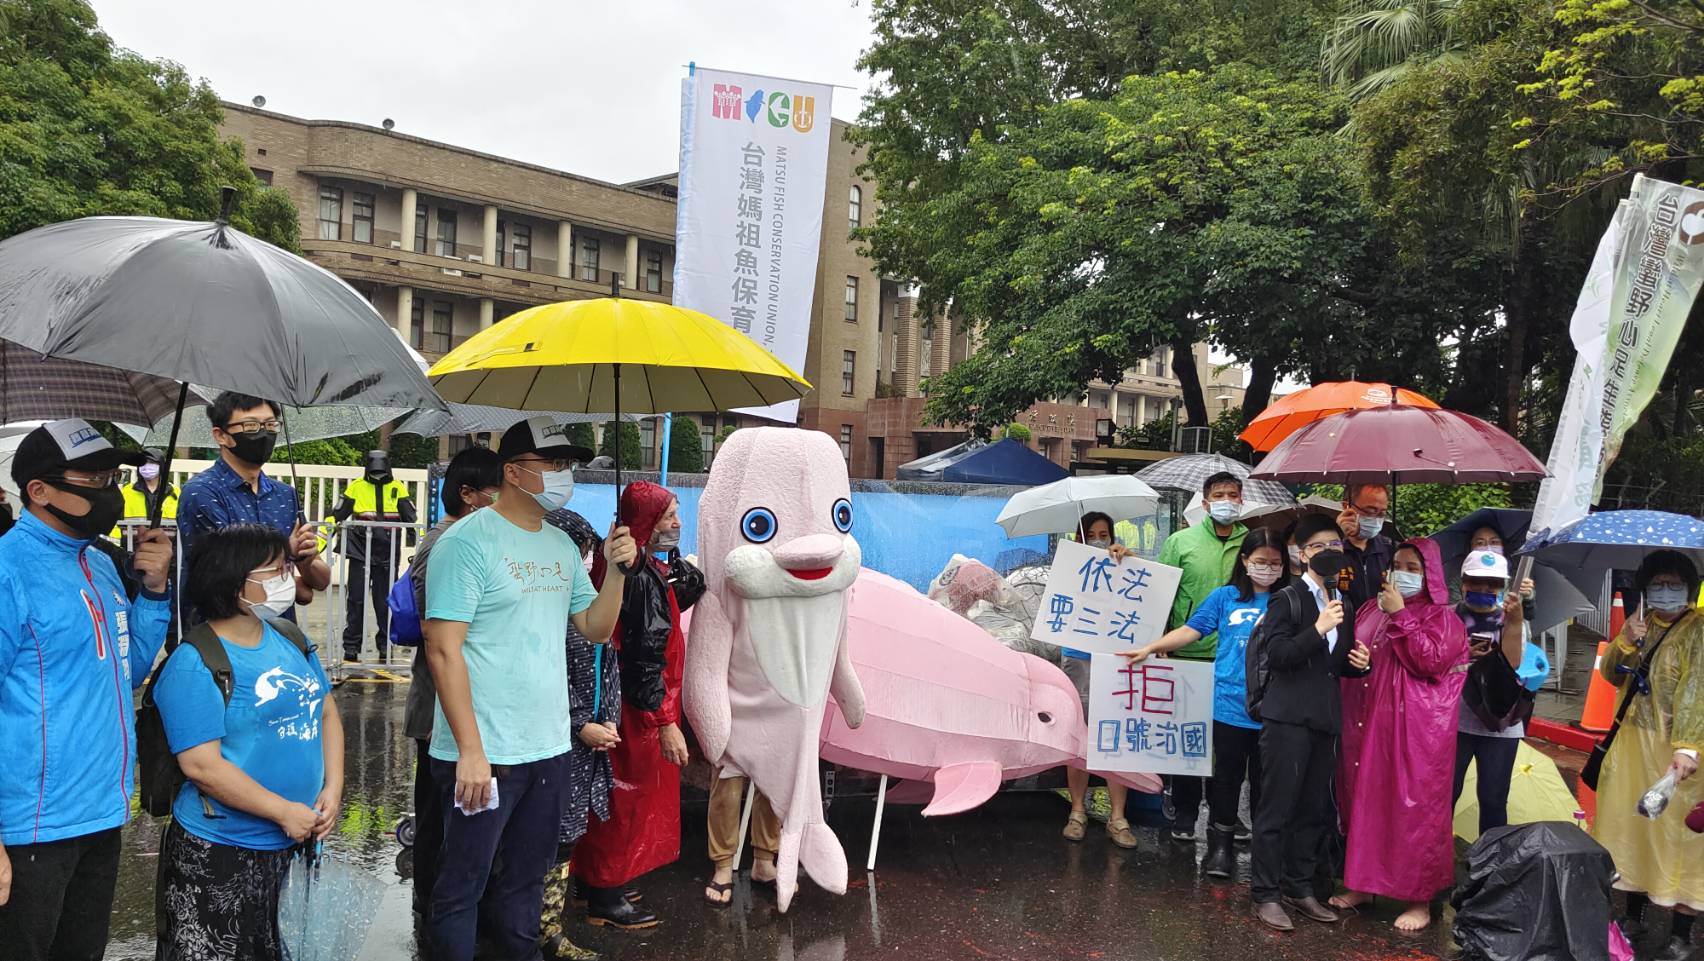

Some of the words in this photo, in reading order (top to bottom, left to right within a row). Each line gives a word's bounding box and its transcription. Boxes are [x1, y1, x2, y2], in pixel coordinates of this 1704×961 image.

[775, 146, 788, 184] MATSU
[773, 186, 785, 211] FISH
[730, 141, 766, 334] 台灣媽祖魚保育
[768, 213, 784, 302] CONSERVATION
[1078, 555, 1153, 603] 依法
[1045, 593, 1141, 644] 要三法
[1112, 663, 1175, 715] 拒
[1097, 717, 1207, 757] 口號治國
